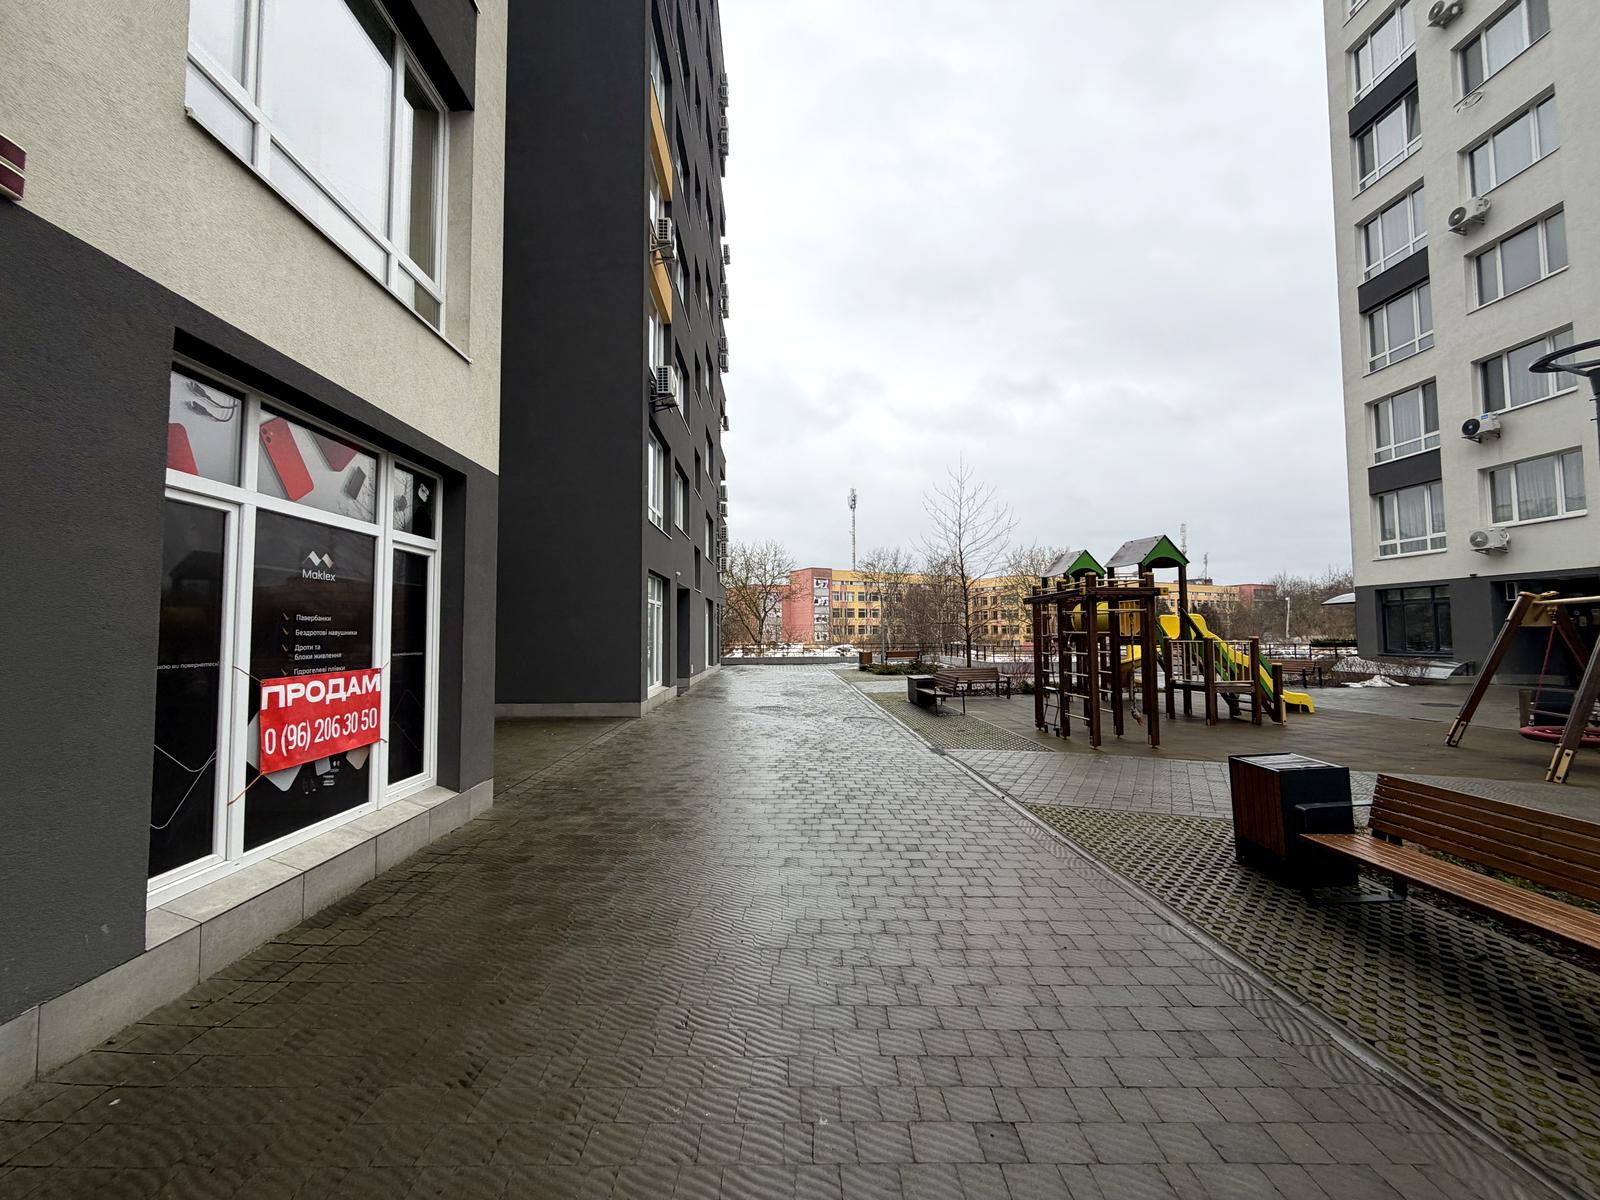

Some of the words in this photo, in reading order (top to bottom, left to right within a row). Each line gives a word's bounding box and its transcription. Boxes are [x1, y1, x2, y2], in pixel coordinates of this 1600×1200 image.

[302, 569, 336, 582] Maklex
[295, 629, 327, 637] Бездротові
[294, 653, 313, 661] блоки
[261, 673, 381, 711] ПРОДАМ
[265, 729, 276, 754] 0
[281, 719, 311, 757] (96)
[314, 715, 341, 743] 206
[342, 711, 358, 736] 30
[361, 707, 378, 731] 50
